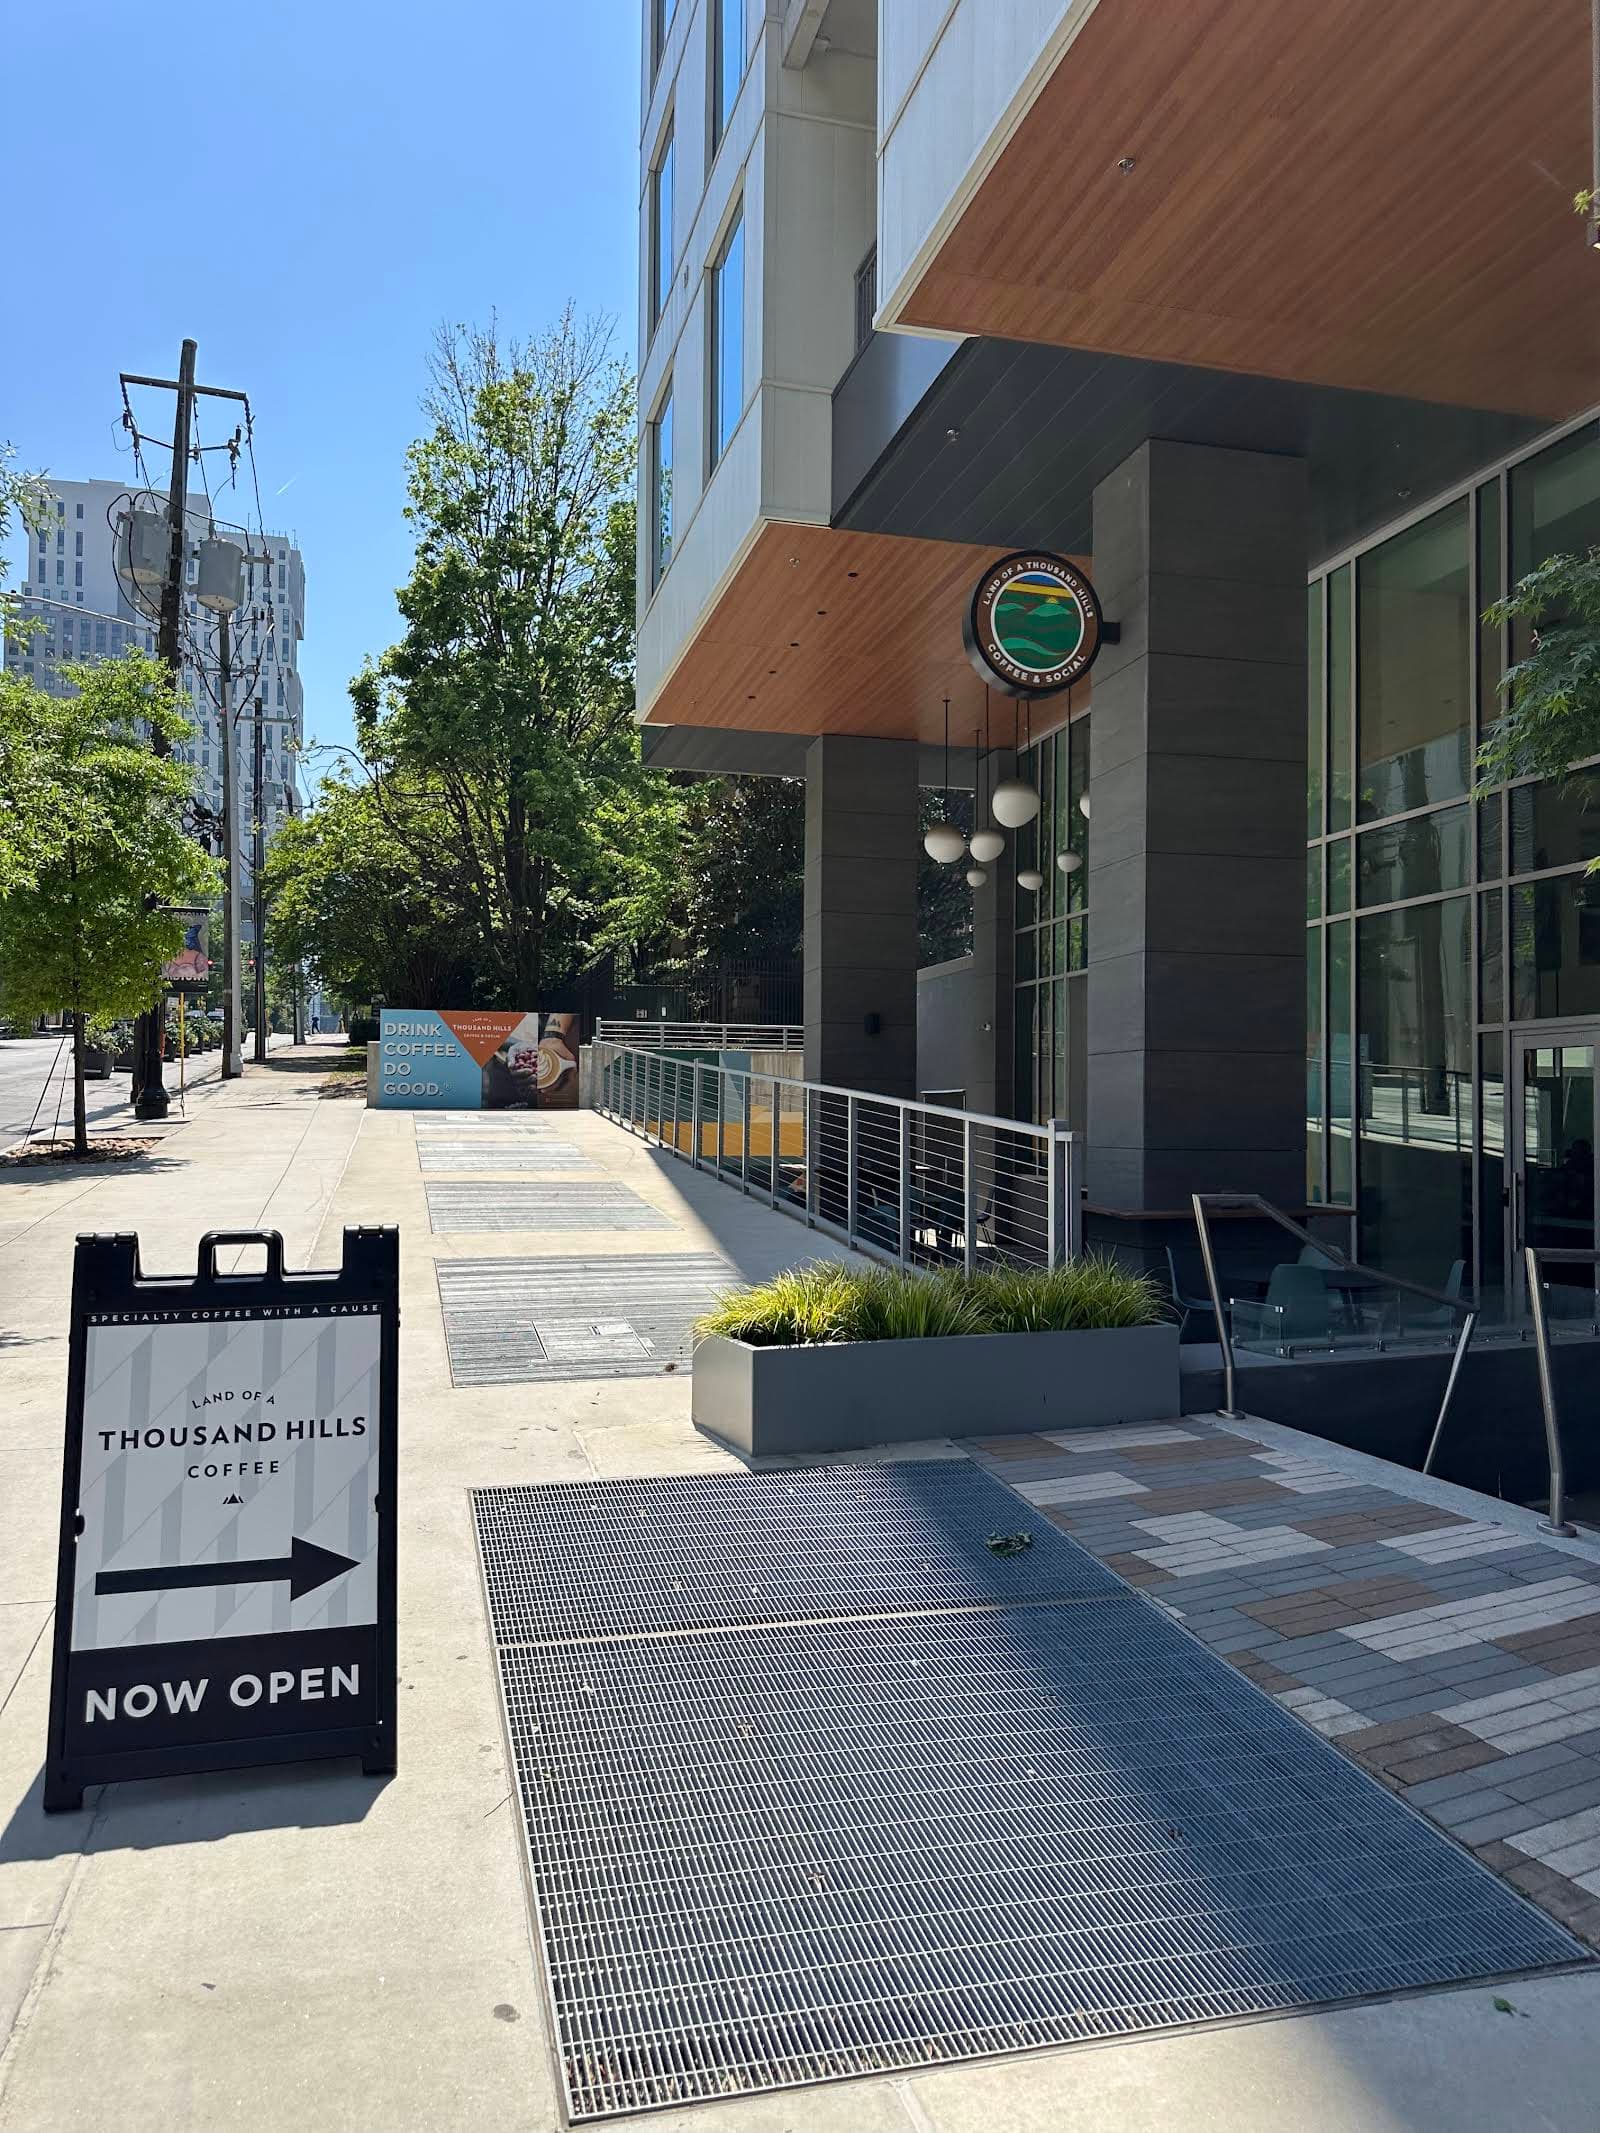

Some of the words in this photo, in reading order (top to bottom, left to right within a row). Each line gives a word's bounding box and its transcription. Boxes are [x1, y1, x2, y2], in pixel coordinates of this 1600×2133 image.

[983, 579, 1001, 606] LAND
[1001, 567, 1014, 579] OF
[1016, 563, 1024, 572] A
[1026, 561, 1078, 588] THOUSAND
[1077, 588, 1094, 618] HILLS
[988, 643, 1029, 681] COFFEE
[1032, 675, 1041, 684] &
[1045, 654, 1086, 683] SOCIAL
[384, 1023, 443, 1037] DRINK
[384, 1042, 461, 1058] COFFEE.
[384, 1062, 412, 1076] DO
[384, 1082, 444, 1097] GOOD.
[91, 1312, 180, 1323] SPECIALTY
[191, 1310, 252, 1319] COFFEE
[262, 1307, 301, 1316] WITH
[312, 1306, 319, 1314] A
[330, 1304, 378, 1313] CAUSE
[192, 1390, 235, 1409] LAND
[242, 1390, 262, 1401] OF
[266, 1395, 276, 1405] A
[98, 1422, 276, 1451] THOUSAND
[286, 1416, 366, 1441] HILLS
[187, 1460, 279, 1478] COFFEE
[85, 1678, 209, 1723] NOW
[229, 1663, 359, 1707] OPEN
